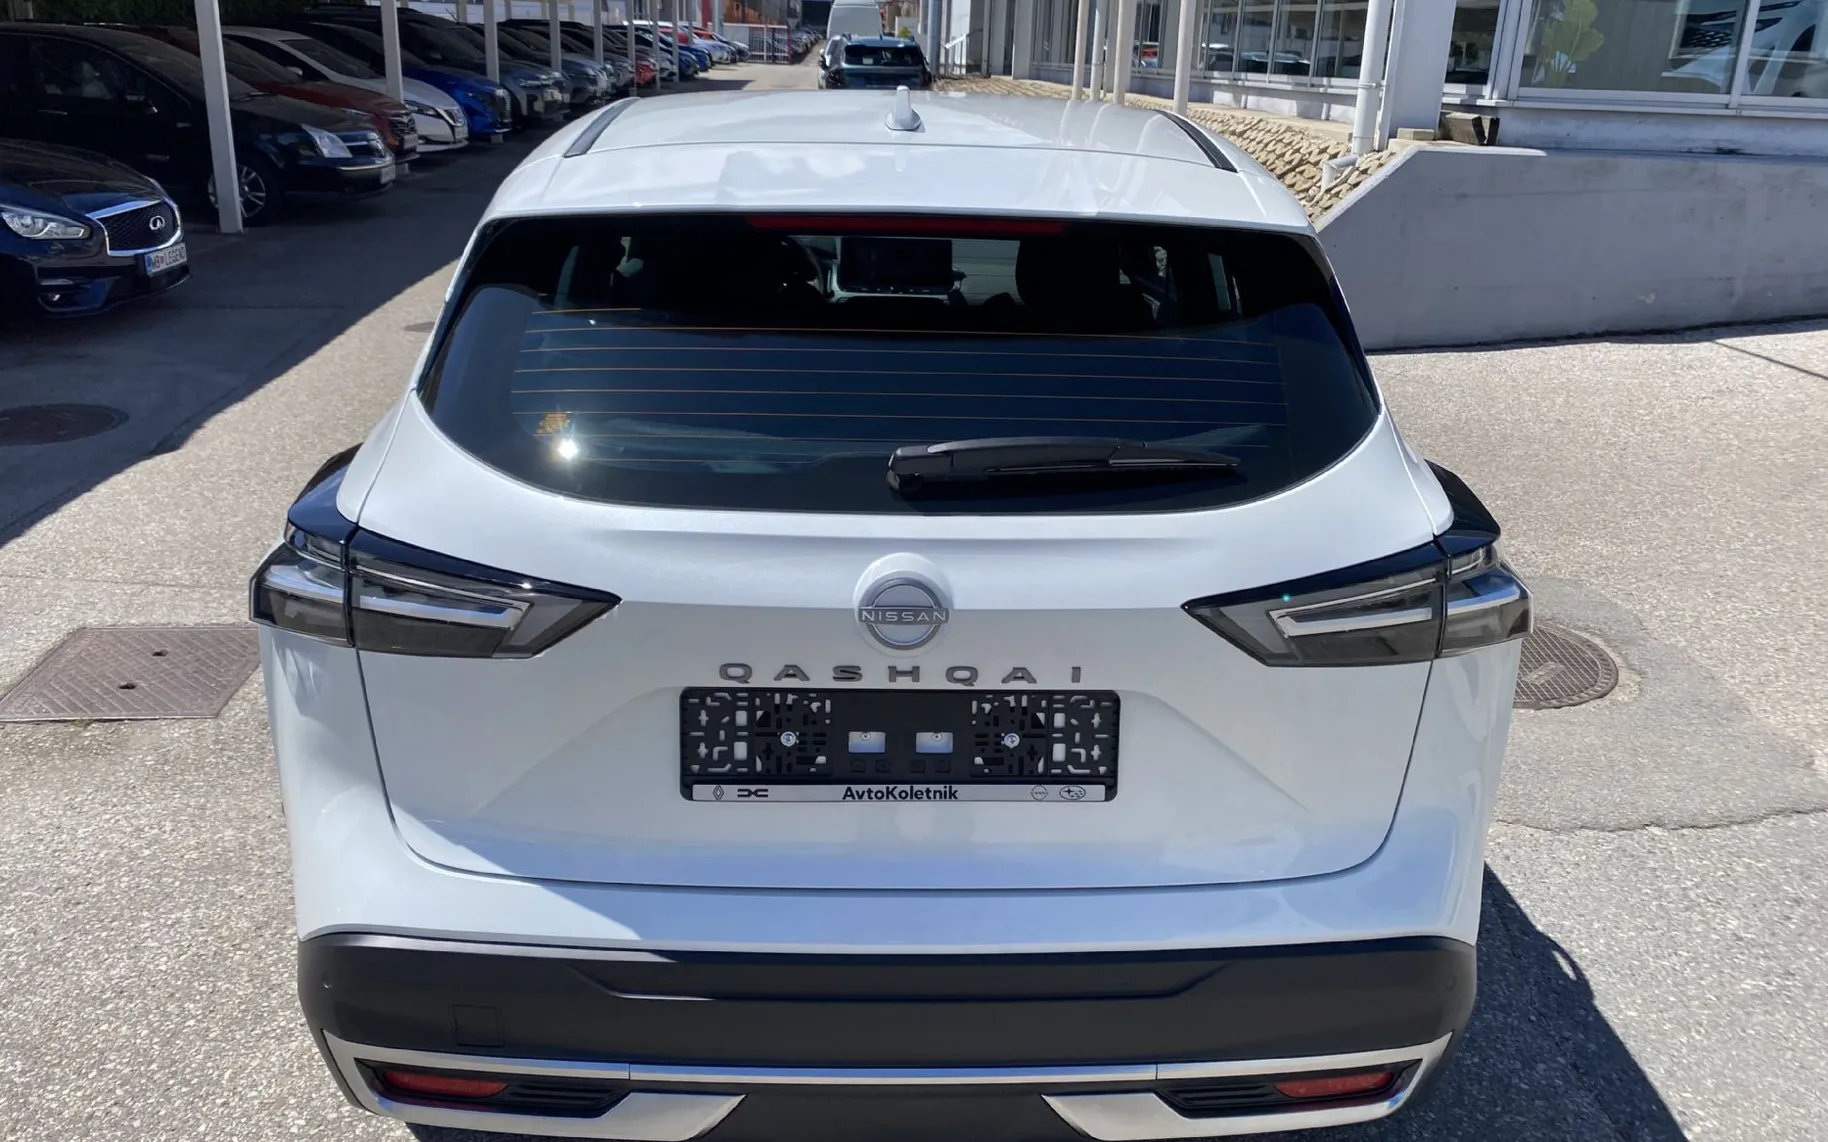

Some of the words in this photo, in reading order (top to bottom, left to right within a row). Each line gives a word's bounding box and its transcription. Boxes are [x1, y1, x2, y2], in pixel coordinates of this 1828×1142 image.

[861, 609, 947, 622] NISSAN
[718, 662, 1082, 687] QASHQAI
[842, 785, 958, 800] AvtoKoletnik
